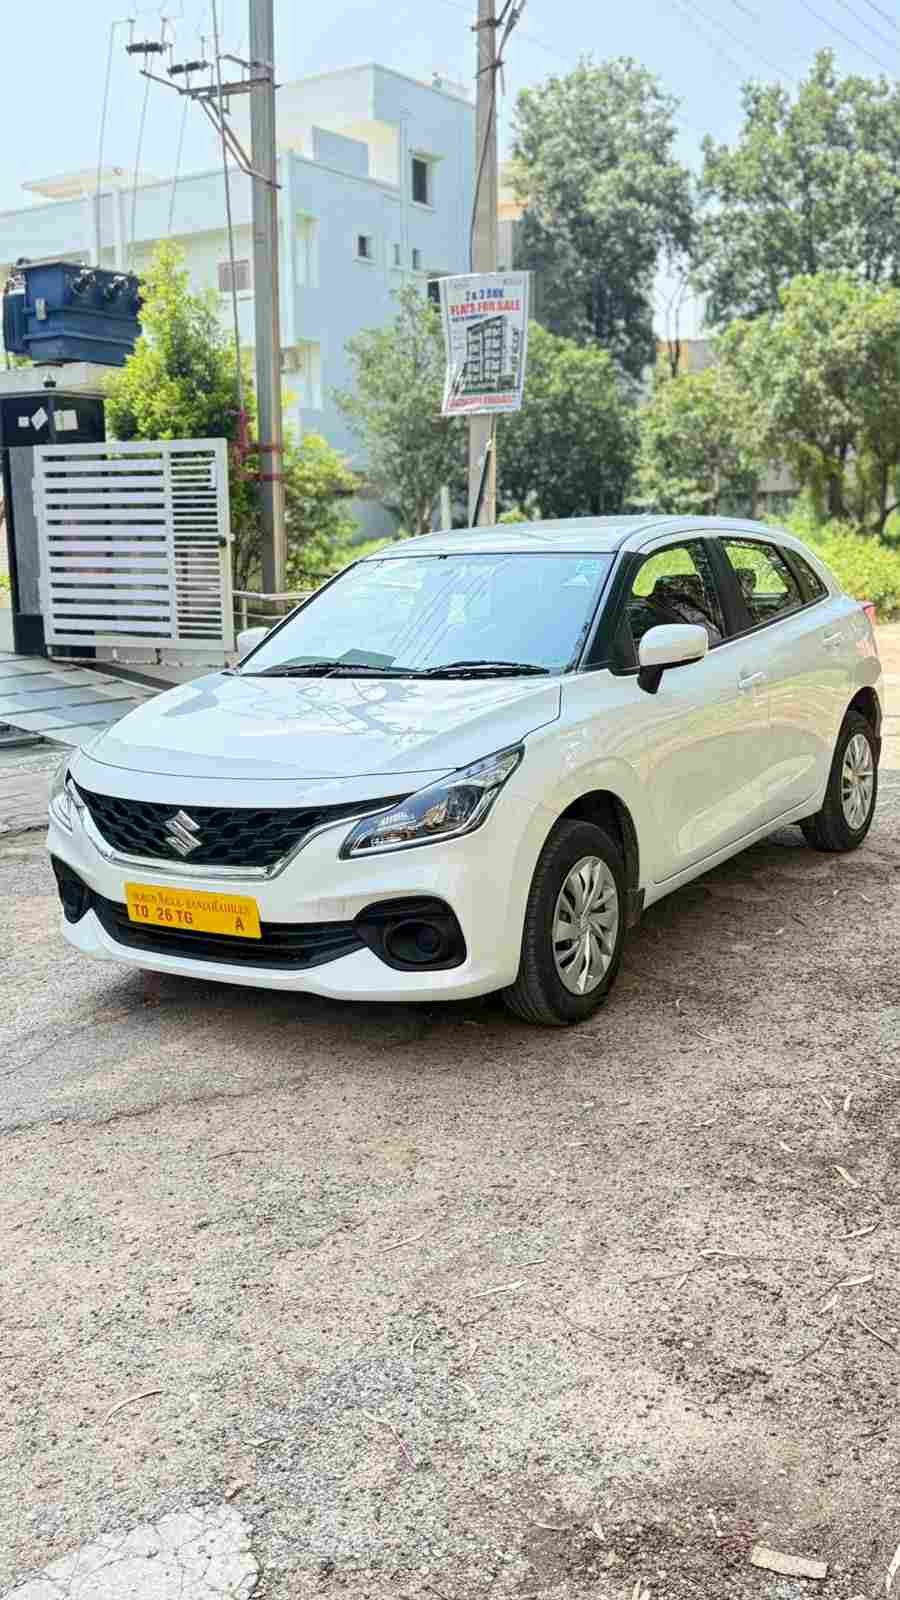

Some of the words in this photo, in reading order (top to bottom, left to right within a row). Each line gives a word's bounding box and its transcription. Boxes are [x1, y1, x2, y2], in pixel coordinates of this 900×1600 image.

[449, 303, 476, 316] FLATS
[477, 301, 496, 313] FOR
[496, 299, 520, 312] SALE
[157, 907, 173, 921] 26
[175, 910, 193, 924] TG
[235, 915, 246, 931] A
